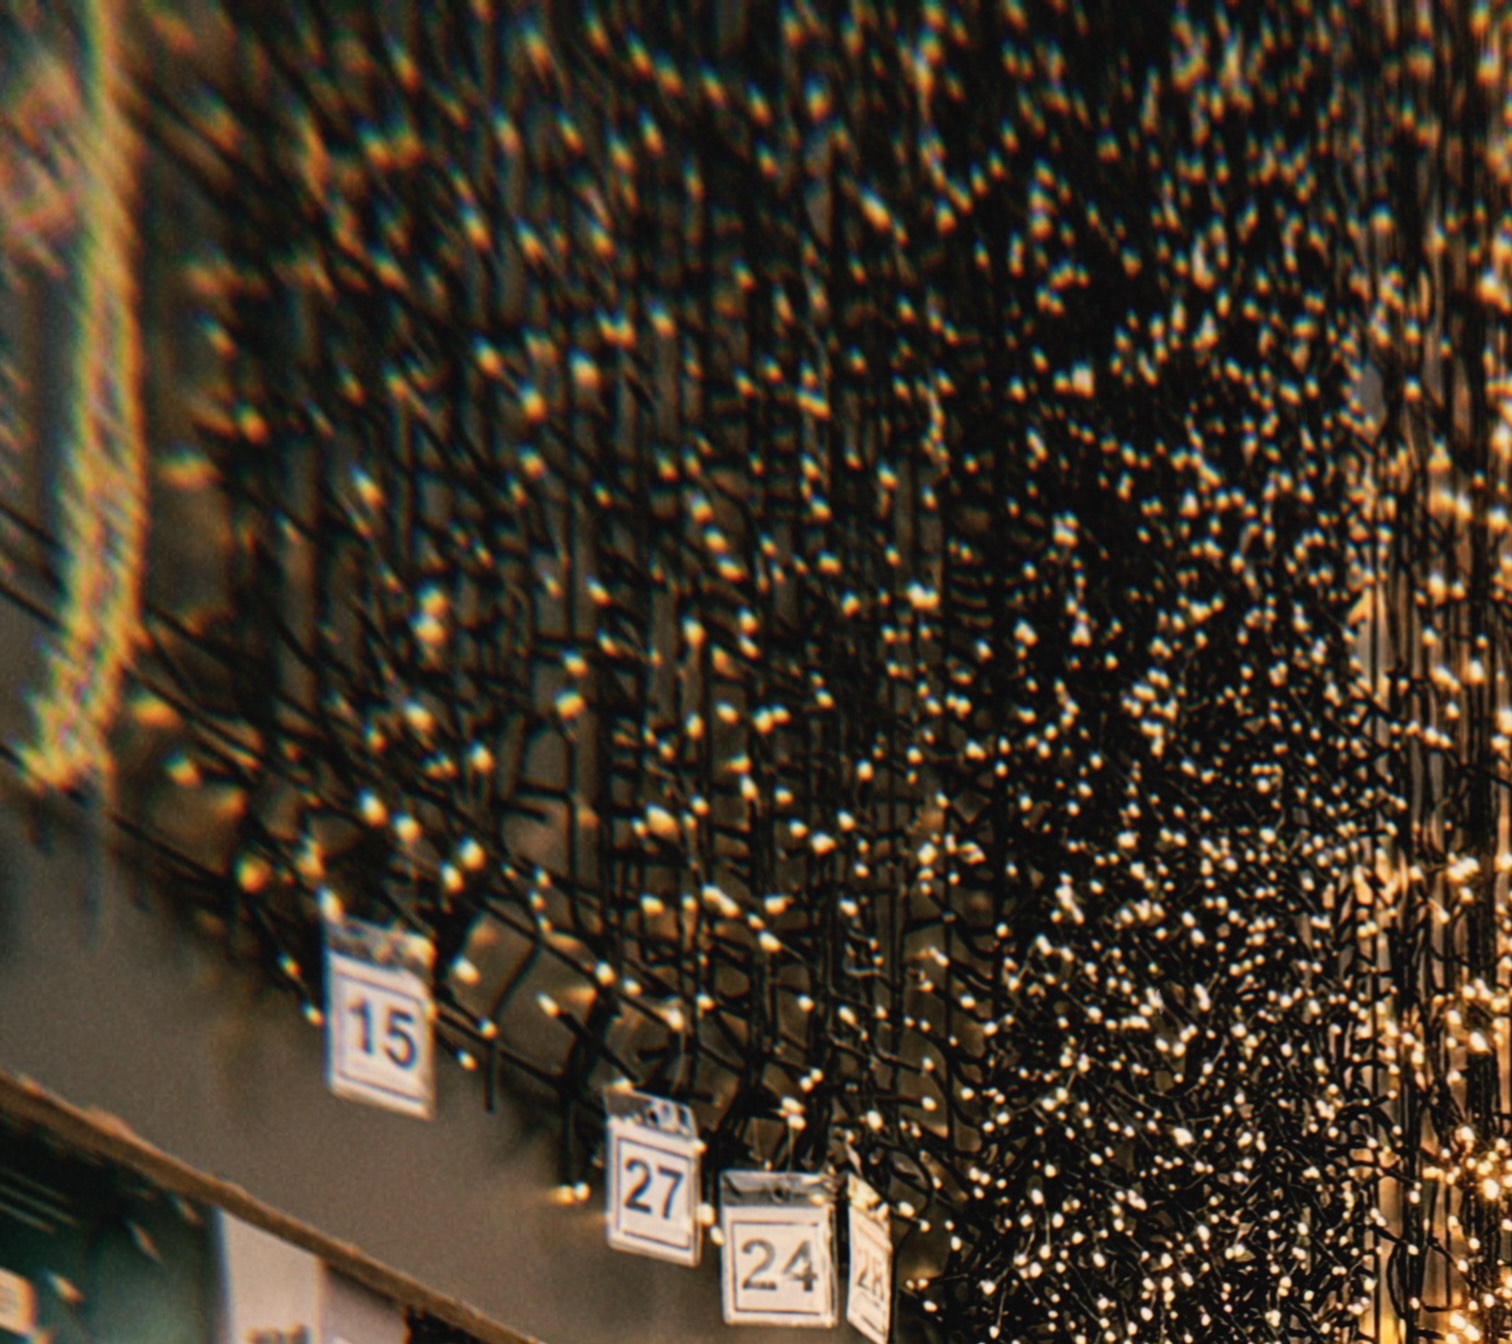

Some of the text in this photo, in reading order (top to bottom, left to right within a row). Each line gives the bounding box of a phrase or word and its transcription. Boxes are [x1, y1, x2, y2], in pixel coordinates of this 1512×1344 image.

[349, 1000, 417, 1070] 15
[623, 1157, 685, 1221] 27
[740, 1238, 819, 1293] 24
